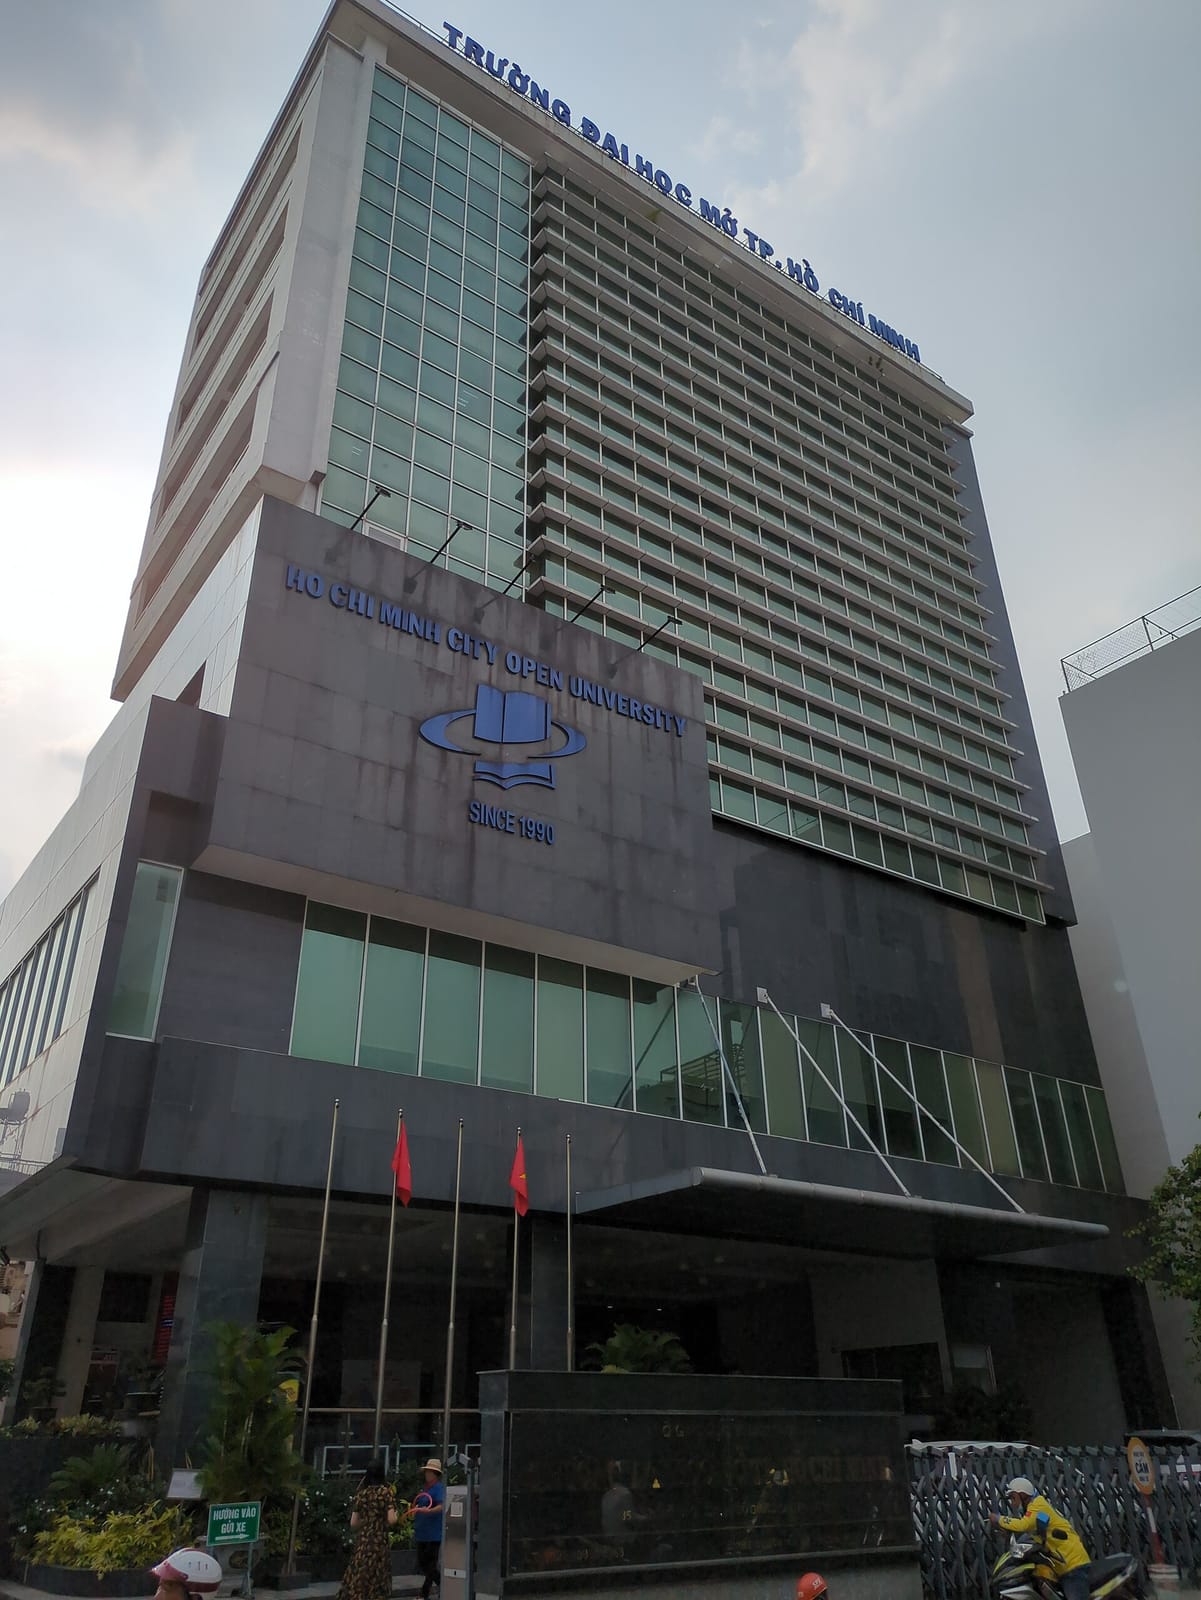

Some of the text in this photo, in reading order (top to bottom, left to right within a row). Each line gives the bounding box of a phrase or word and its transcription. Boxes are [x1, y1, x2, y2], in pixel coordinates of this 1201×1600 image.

[443, 21, 571, 127] TRƯỜNG
[699, 197, 738, 237] MỞ
[828, 288, 865, 326] CHÍ
[868, 313, 921, 363] MINH
[285, 564, 687, 737] HO CHI MINH CITY OPEN UNIVERSITY
[468, 800, 556, 845] SINCE 1990
[235, 1522, 247, 1533] XE
[241, 1506, 257, 1518] VÀO
